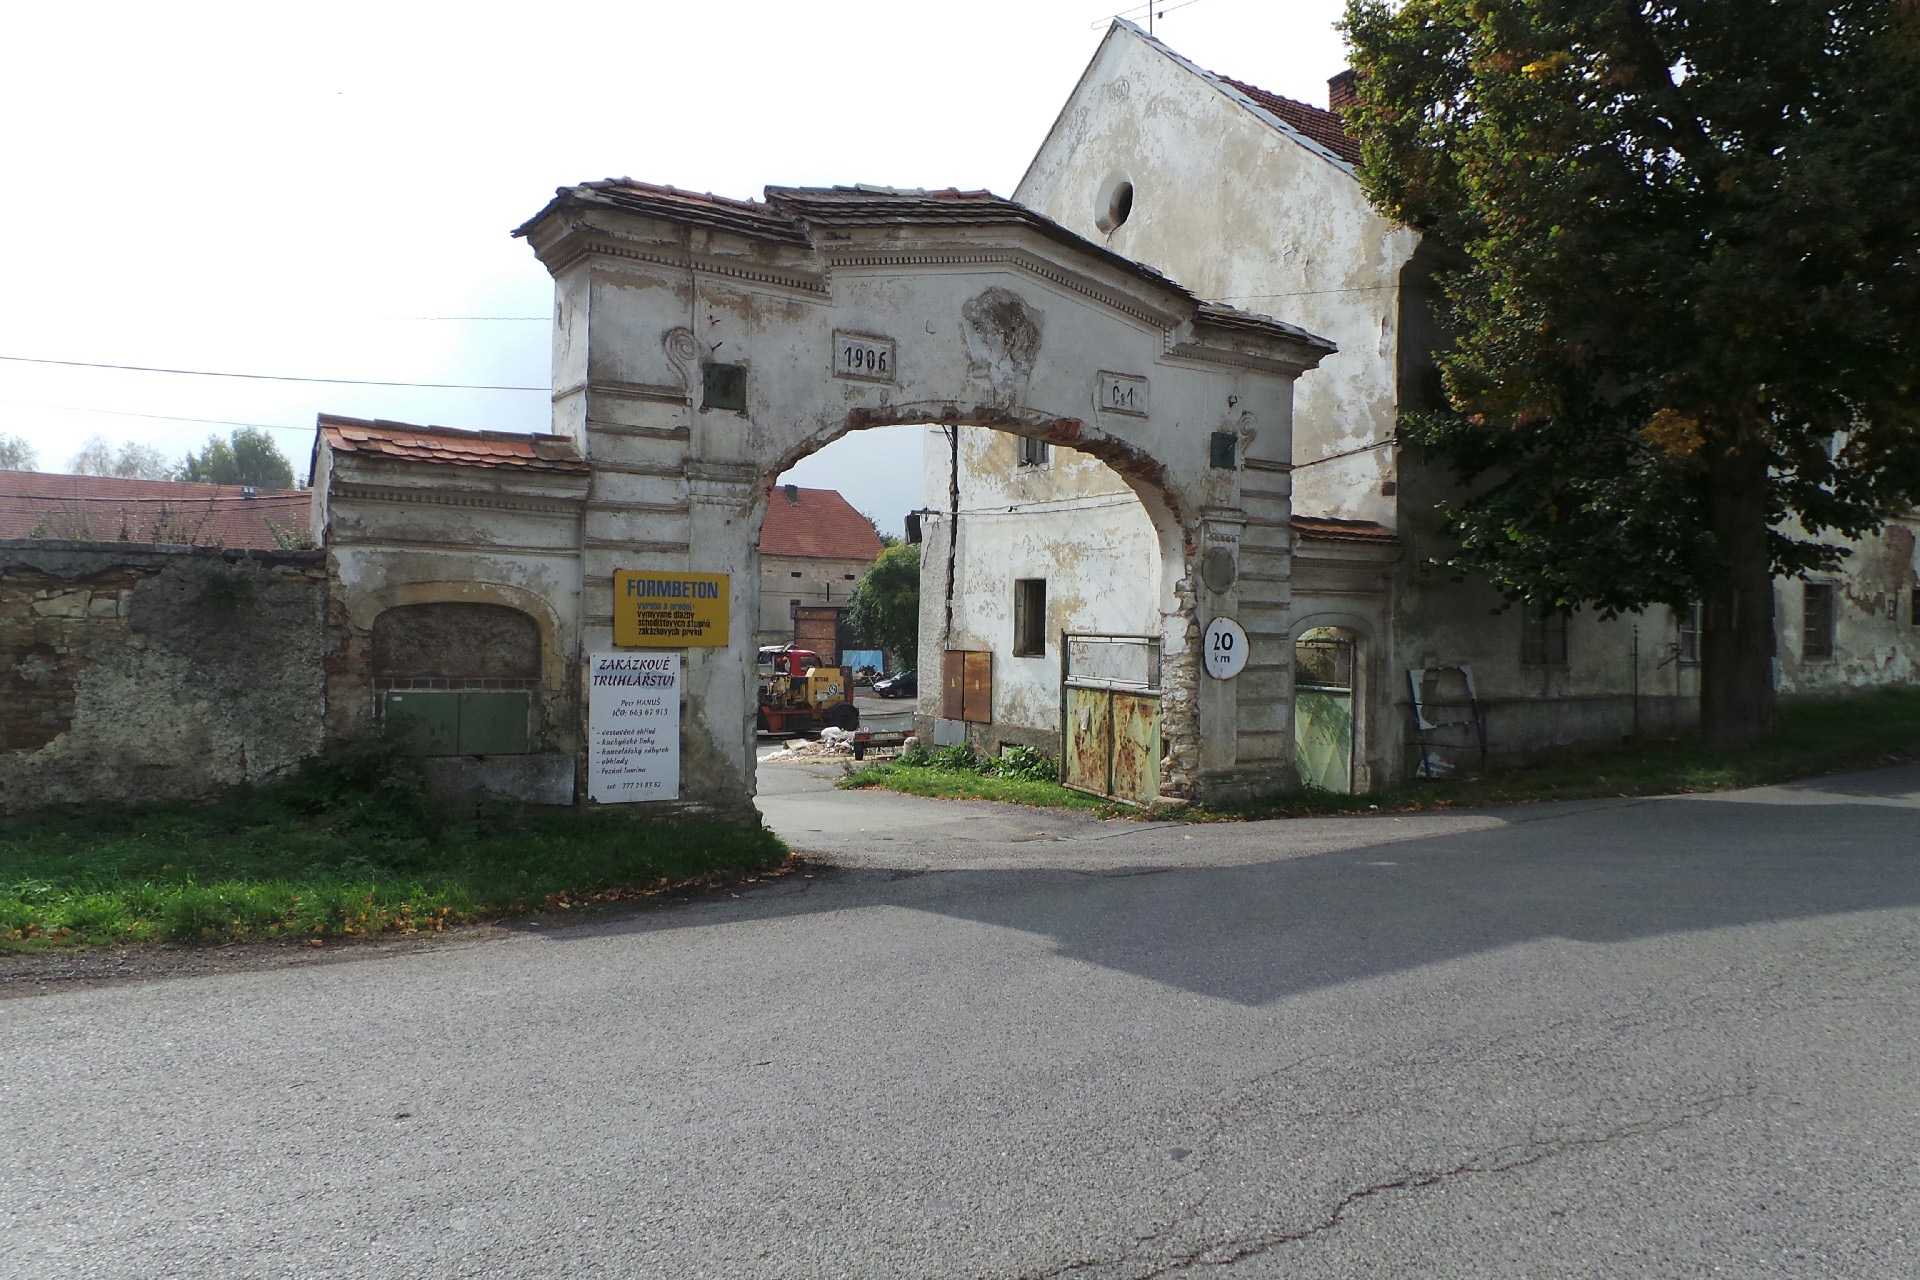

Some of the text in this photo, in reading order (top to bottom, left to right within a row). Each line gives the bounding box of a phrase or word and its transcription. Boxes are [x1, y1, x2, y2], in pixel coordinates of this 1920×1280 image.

[844, 346, 887, 371] 1906
[627, 579, 718, 599] FORMBETON
[1213, 632, 1233, 651] 20
[599, 656, 671, 671] ZAKÁZKOVÉ
[1214, 652, 1230, 663] km
[593, 672, 675, 686] TRUHLÁŘSTVÍ
[620, 697, 661, 707] Petr HANUŠ
[655, 708, 668, 716] 913
[643, 747, 669, 755] nábytek
[601, 757, 629, 765] obklady
